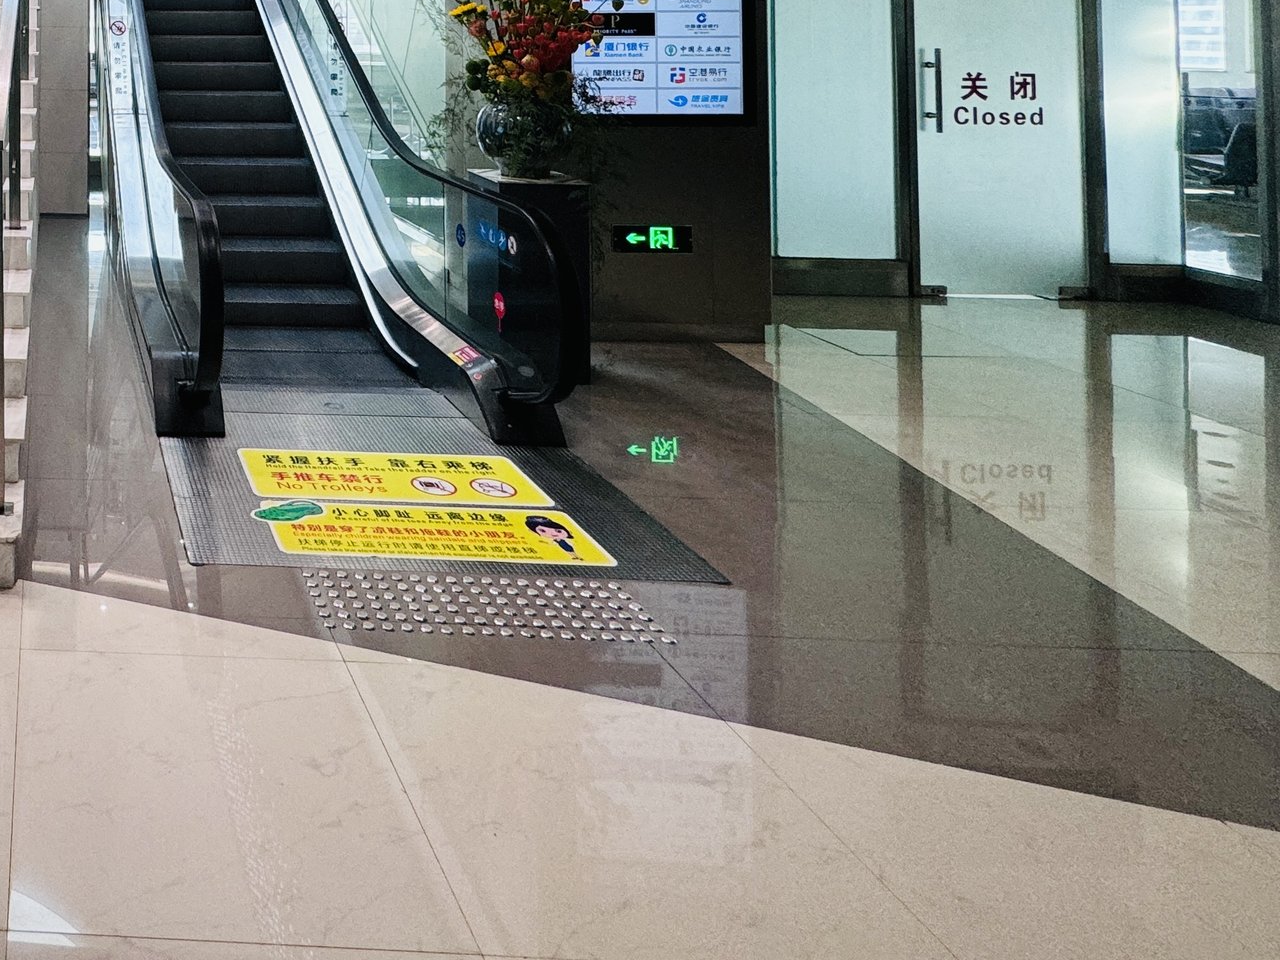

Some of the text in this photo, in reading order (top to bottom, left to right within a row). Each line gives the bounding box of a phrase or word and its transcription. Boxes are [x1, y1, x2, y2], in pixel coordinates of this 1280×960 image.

[604, 42, 649, 51] 厦门银行
[960, 71, 1037, 100] 关闭
[953, 106, 1044, 126] Closed
[262, 454, 494, 471] 紧握扶手 靠右乘梯
[271, 471, 385, 484] 手推车禁行
[276, 481, 389, 494] No Trolleys
[331, 507, 510, 522] 小心脚趾 远离边缘
